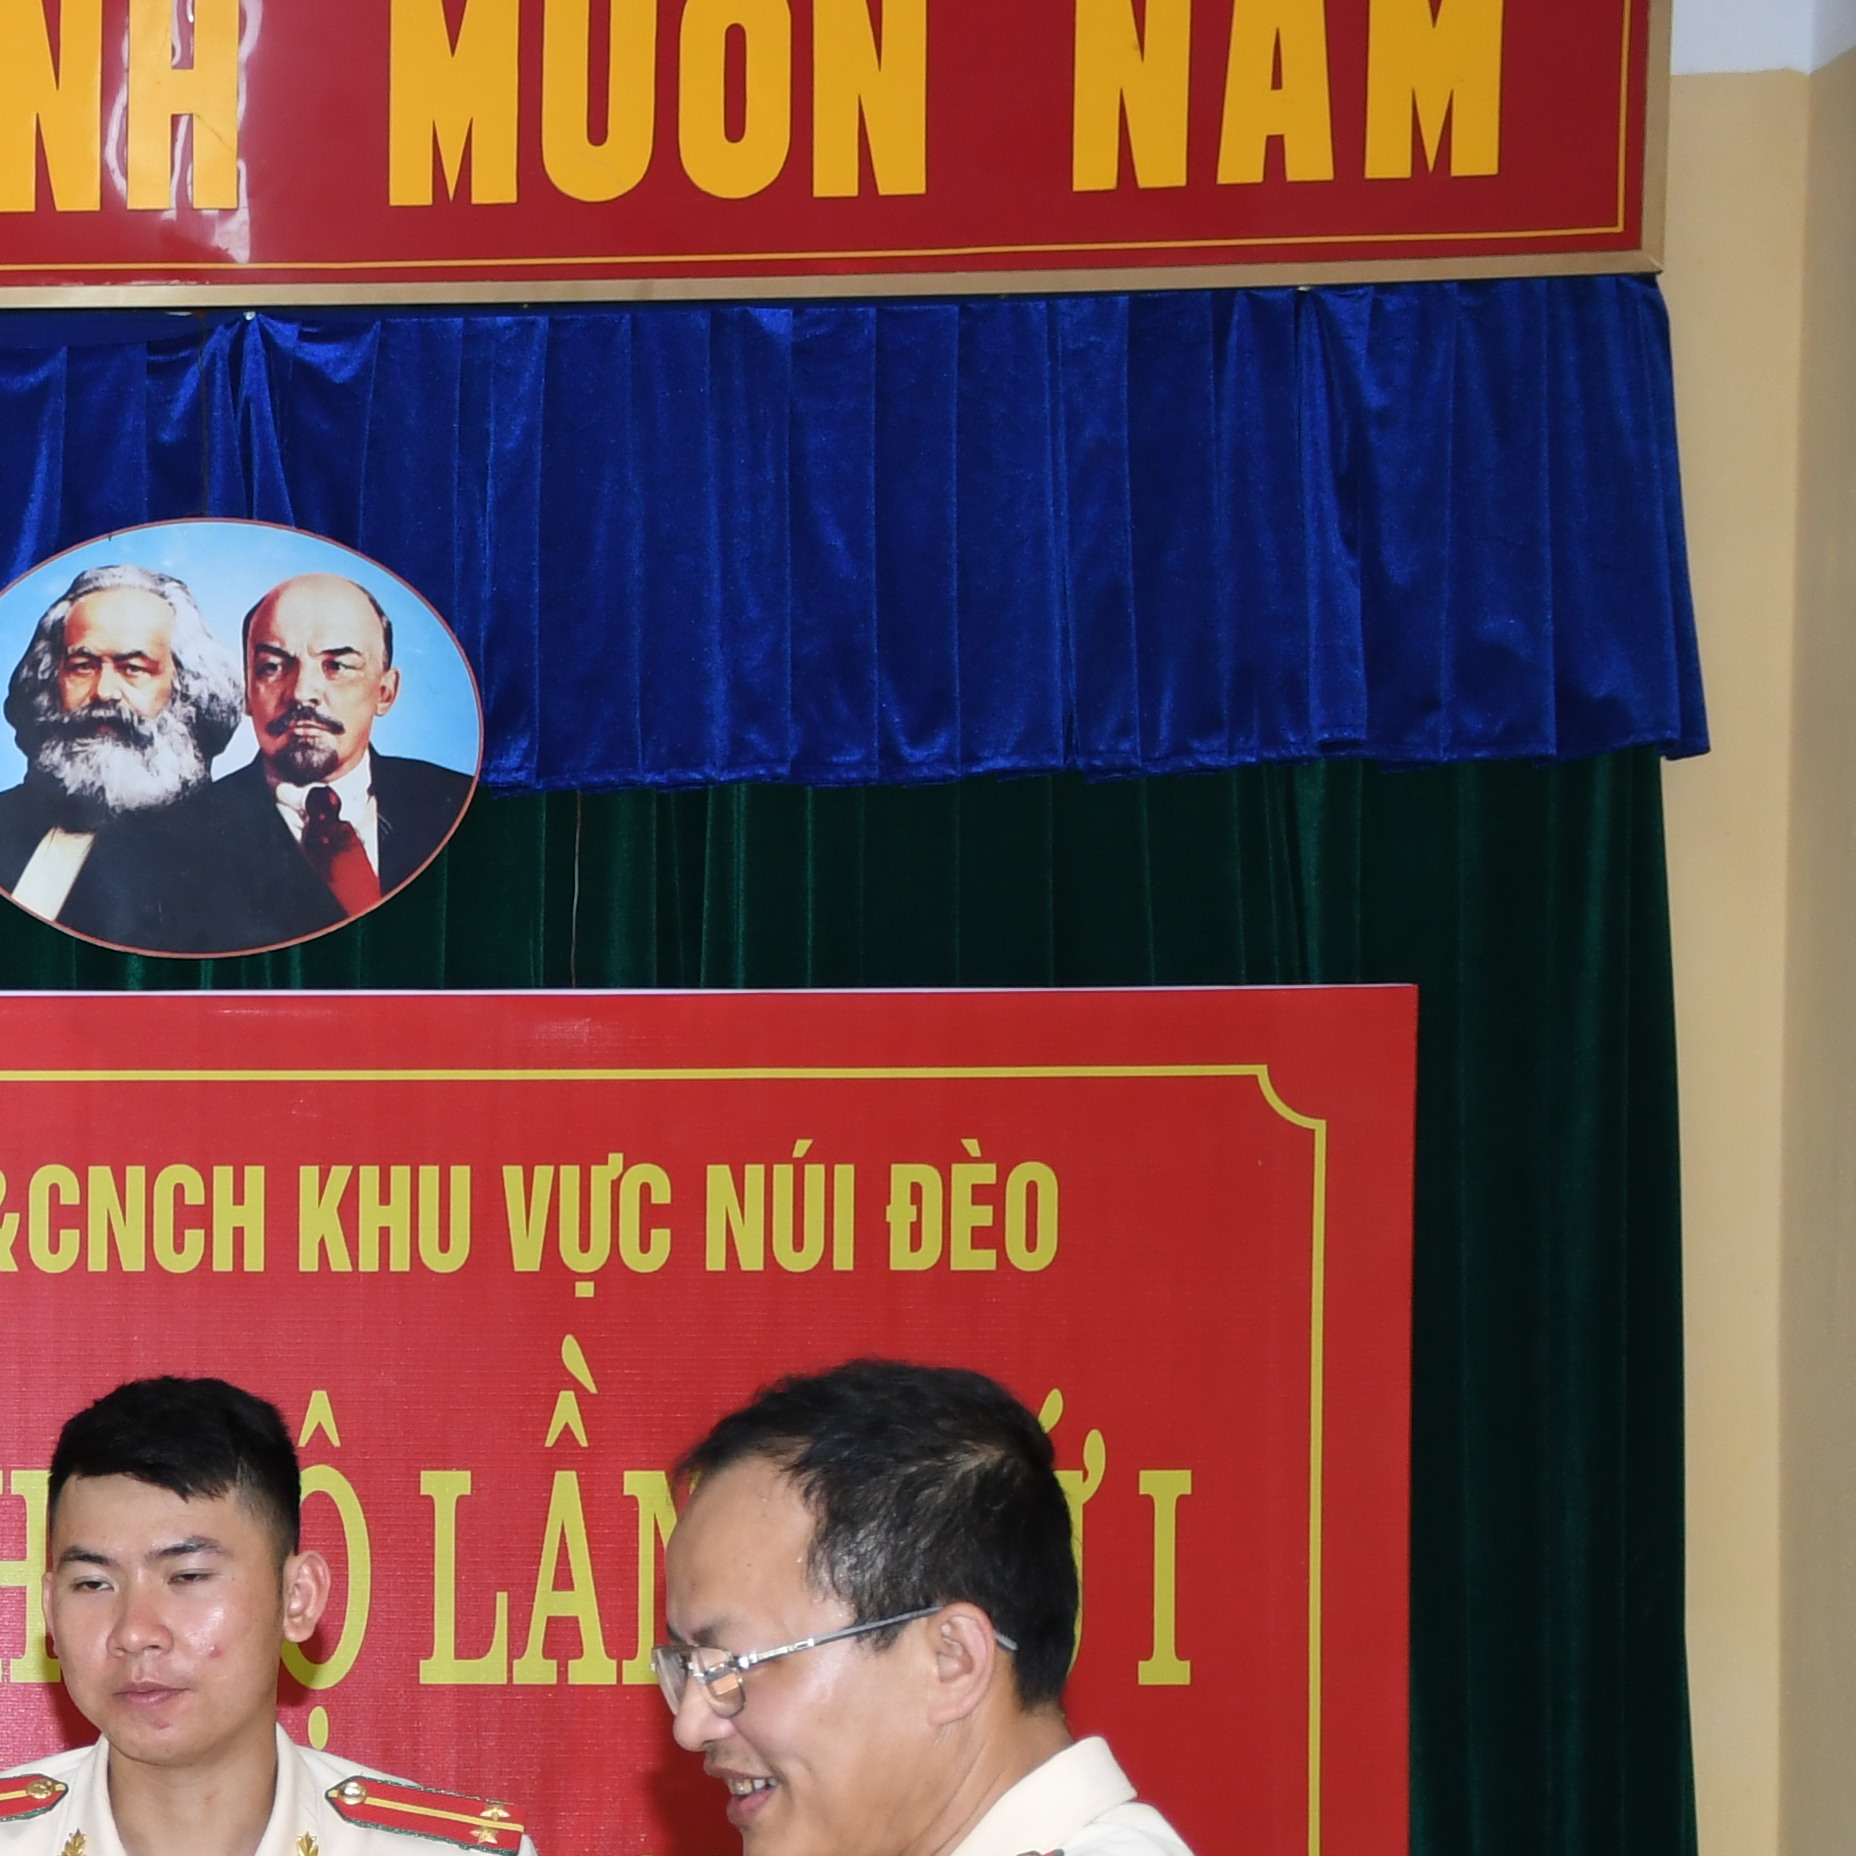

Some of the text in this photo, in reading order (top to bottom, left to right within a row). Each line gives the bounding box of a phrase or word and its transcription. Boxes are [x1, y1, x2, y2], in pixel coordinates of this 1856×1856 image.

[298, 1164, 471, 1273] KHU
[502, 1151, 672, 1298] VỰC
[704, 1138, 855, 1272] NÚI
[885, 1138, 1059, 1273] ĐÈO
[1137, 1468, 1193, 1686] I
